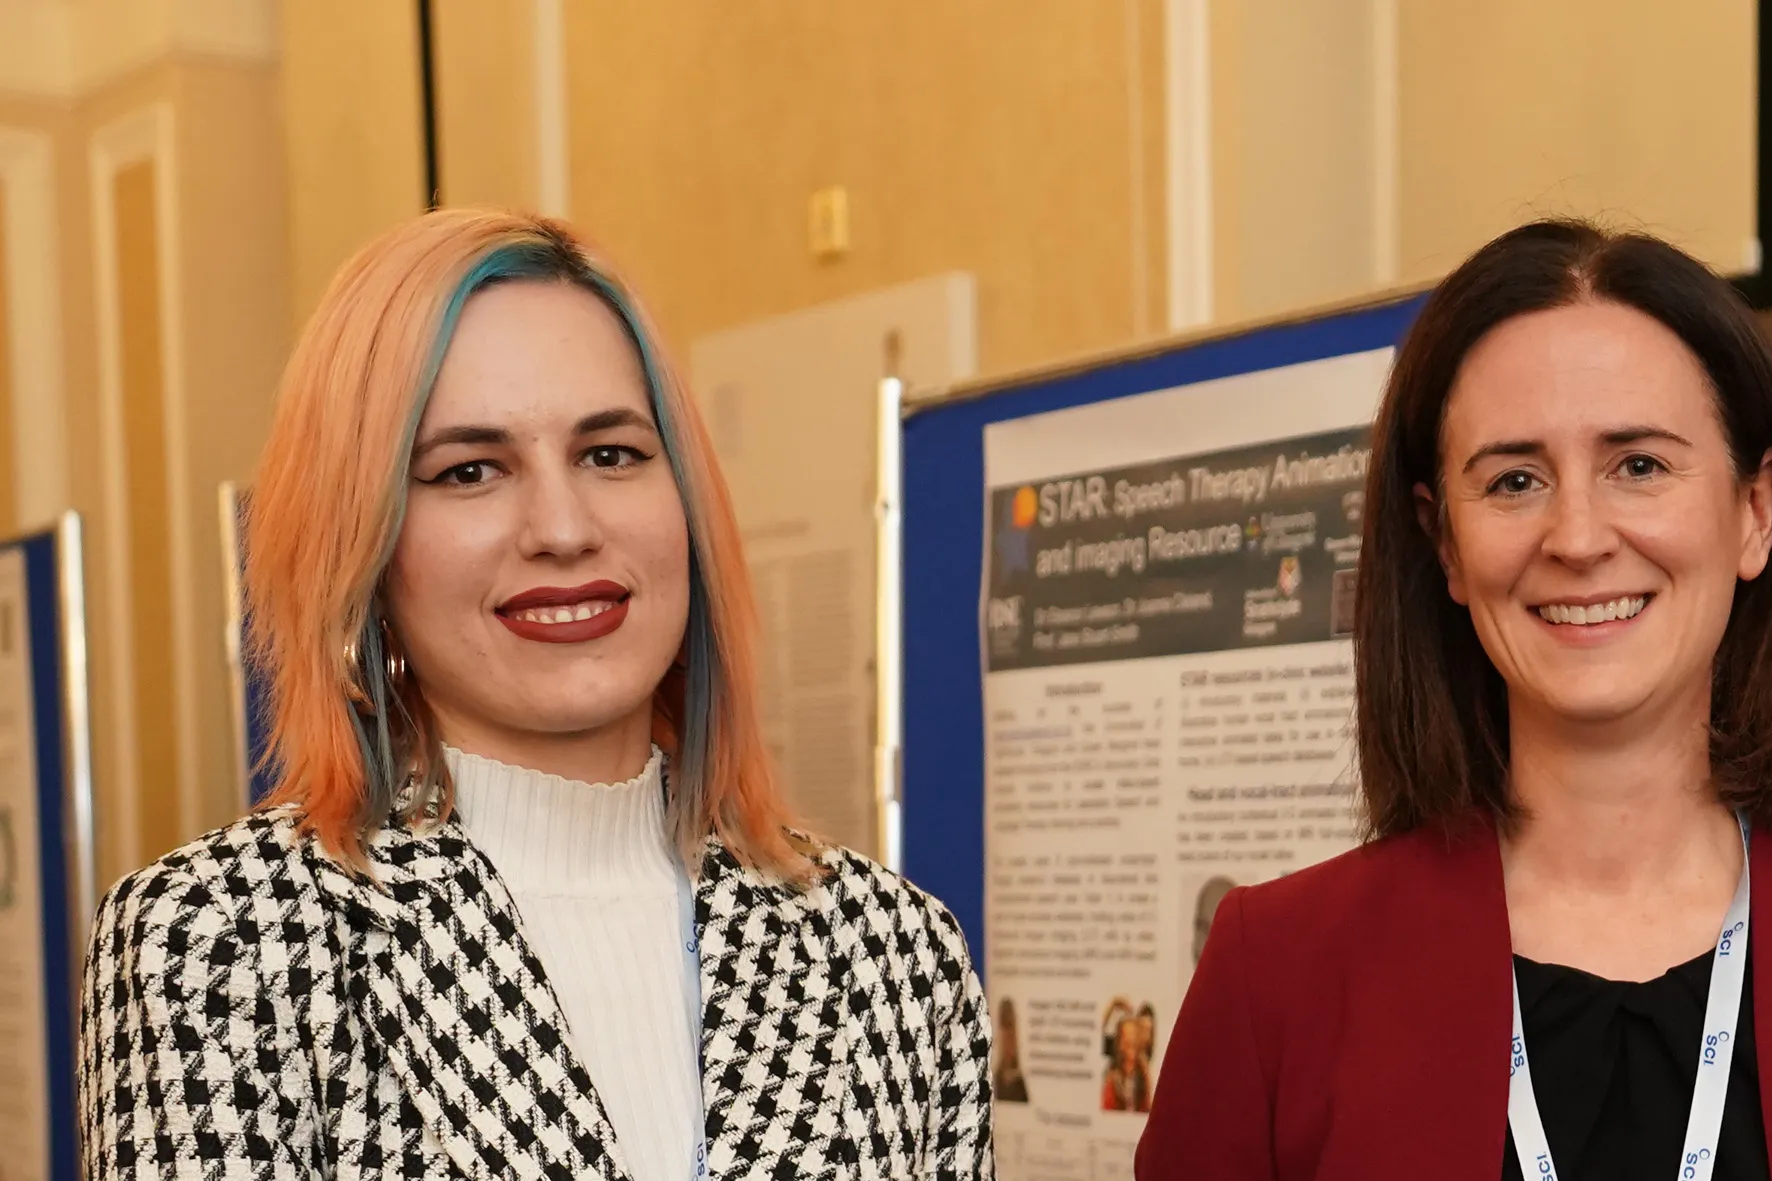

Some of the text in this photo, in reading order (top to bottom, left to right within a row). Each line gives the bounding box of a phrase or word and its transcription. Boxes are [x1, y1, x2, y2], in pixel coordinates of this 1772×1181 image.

[1113, 472, 1186, 519] Speech
[1189, 466, 1270, 504] Therapy
[1036, 539, 1074, 578] and
[1149, 523, 1242, 561] Resource
